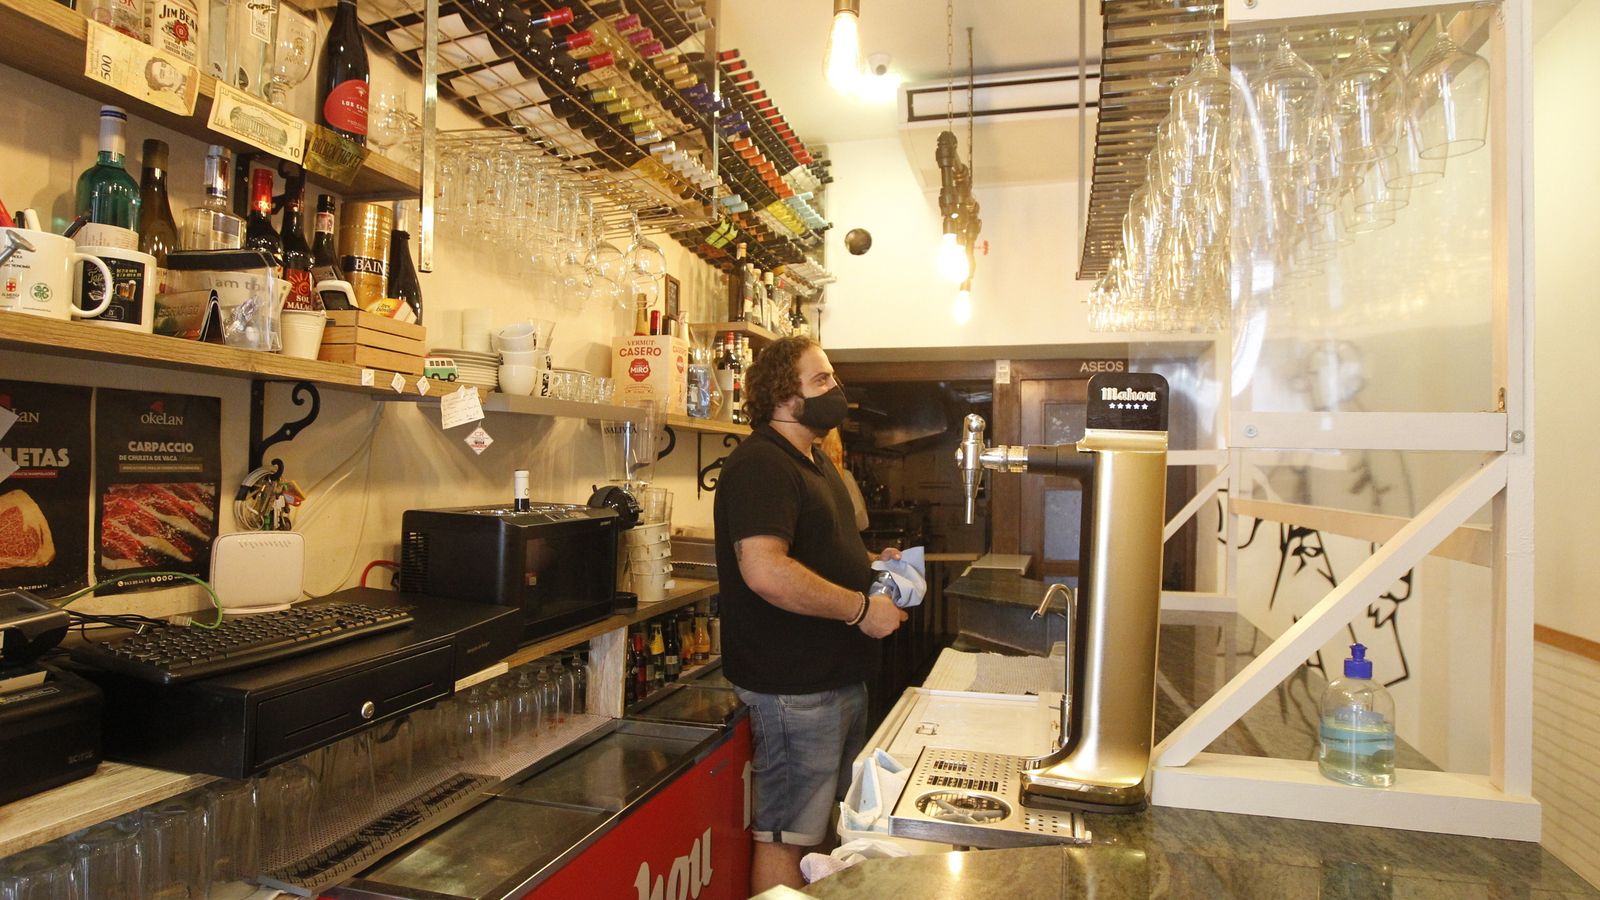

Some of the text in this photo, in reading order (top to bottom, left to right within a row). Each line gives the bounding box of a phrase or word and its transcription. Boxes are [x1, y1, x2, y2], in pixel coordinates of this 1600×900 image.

[159, 4, 178, 19] JIM
[100, 54, 113, 81] 500
[288, 146, 300, 158] 10
[215, 279, 239, 288] am
[619, 346, 662, 357] CASERO
[1080, 361, 1124, 373] ASEOS
[1100, 387, 1157, 402] Mahou
[128, 441, 194, 453] CARPACCIO
[4, 447, 70, 468] LETAS
